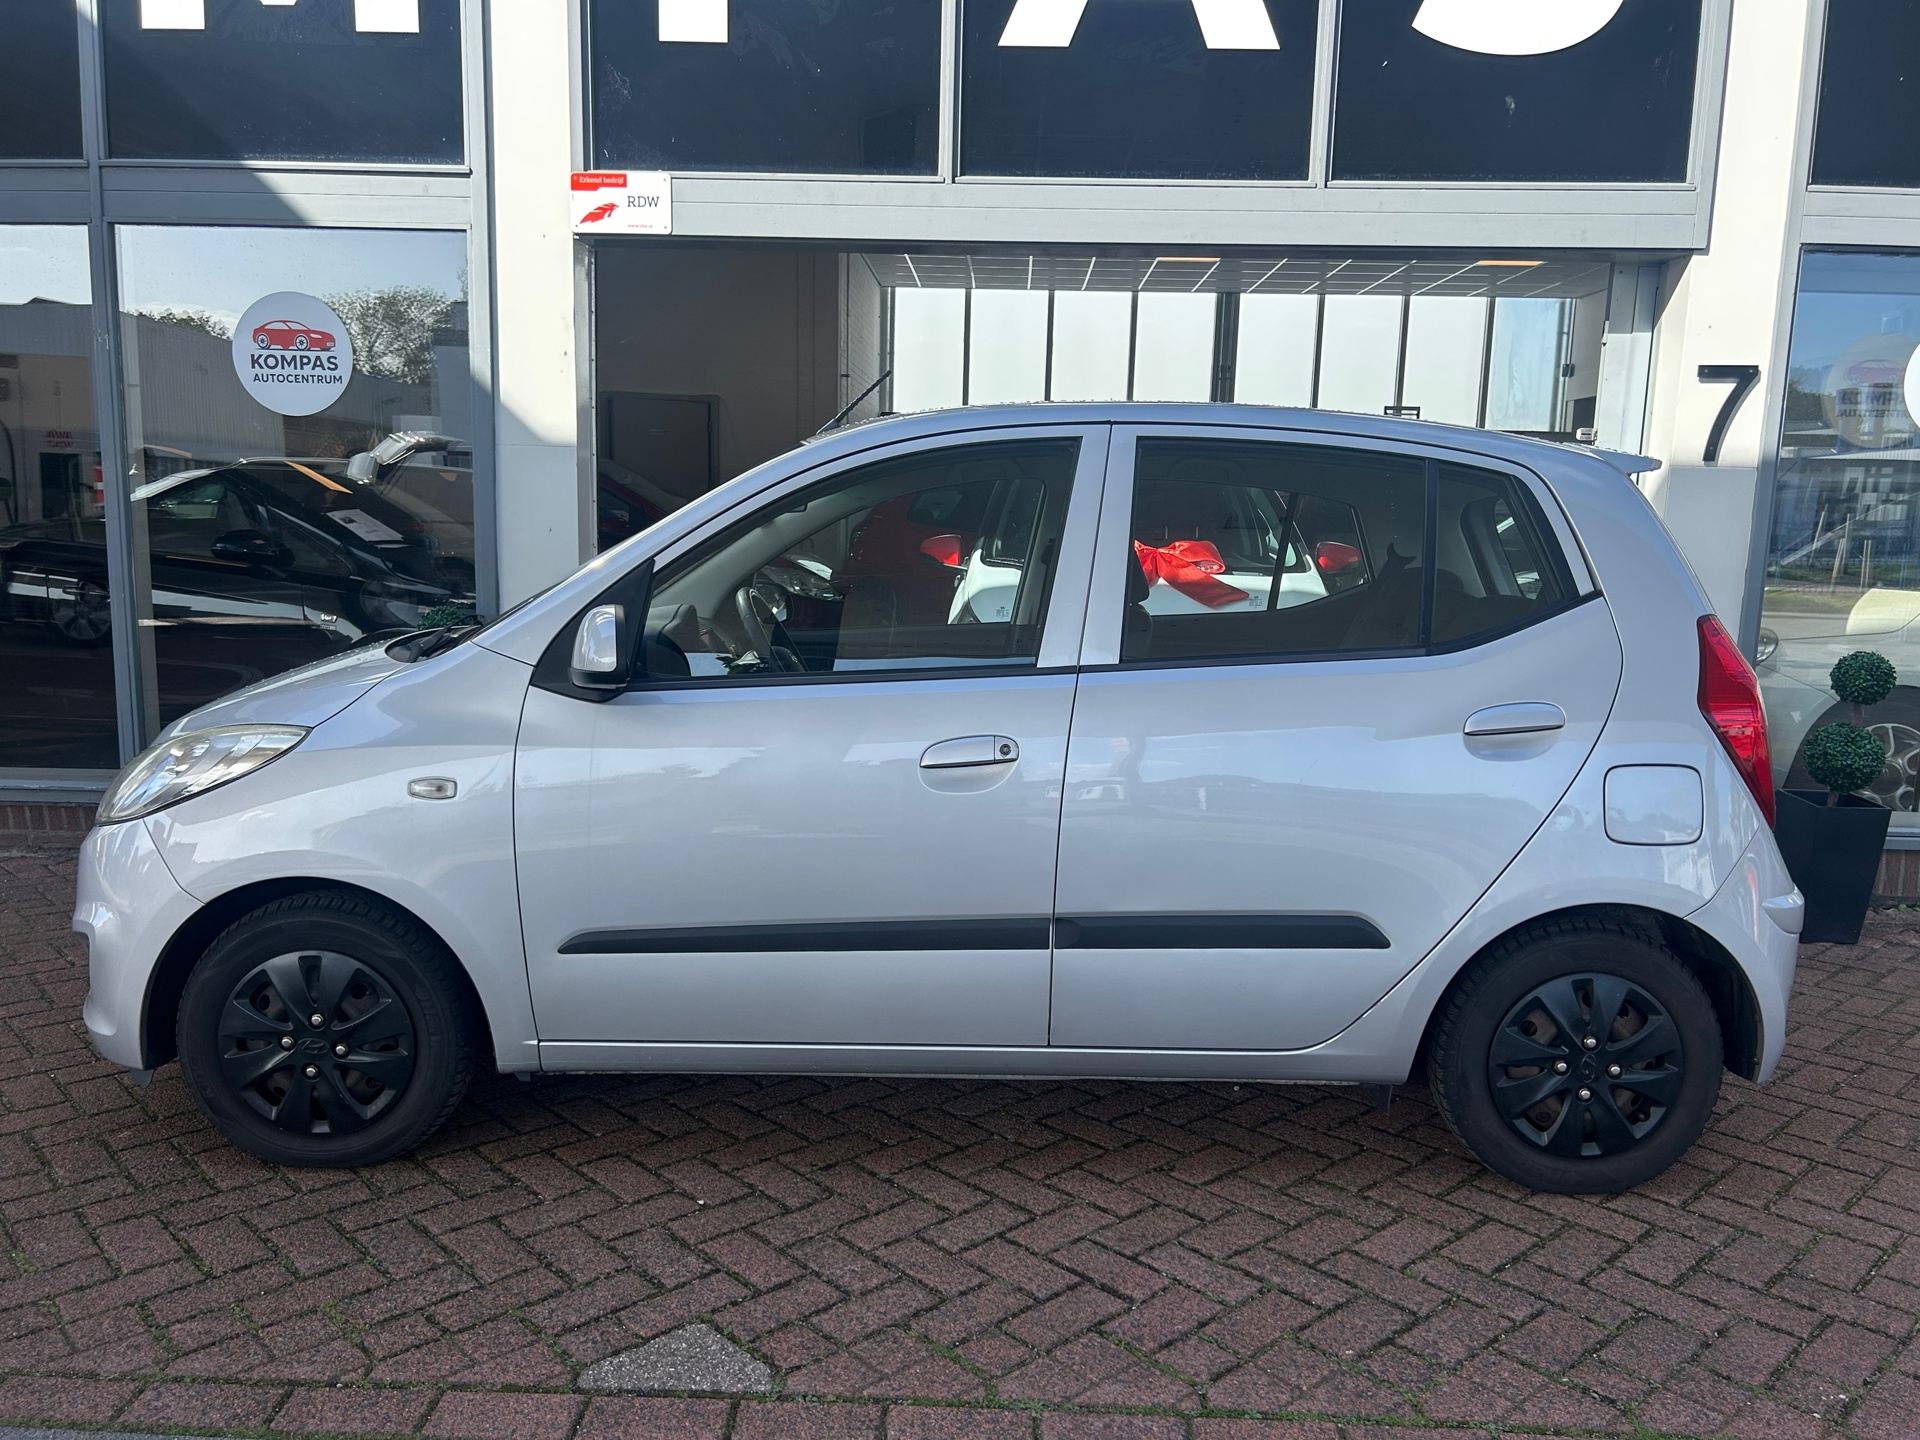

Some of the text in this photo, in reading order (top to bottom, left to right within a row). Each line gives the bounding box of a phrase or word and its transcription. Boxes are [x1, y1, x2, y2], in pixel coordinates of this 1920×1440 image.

[579, 176, 625, 185] Erkend bedrijf
[627, 195, 660, 208] RDW
[250, 353, 339, 371] KOMPAS
[253, 373, 343, 385] AUTOCENTRUM
[1697, 364, 1760, 464] 7
